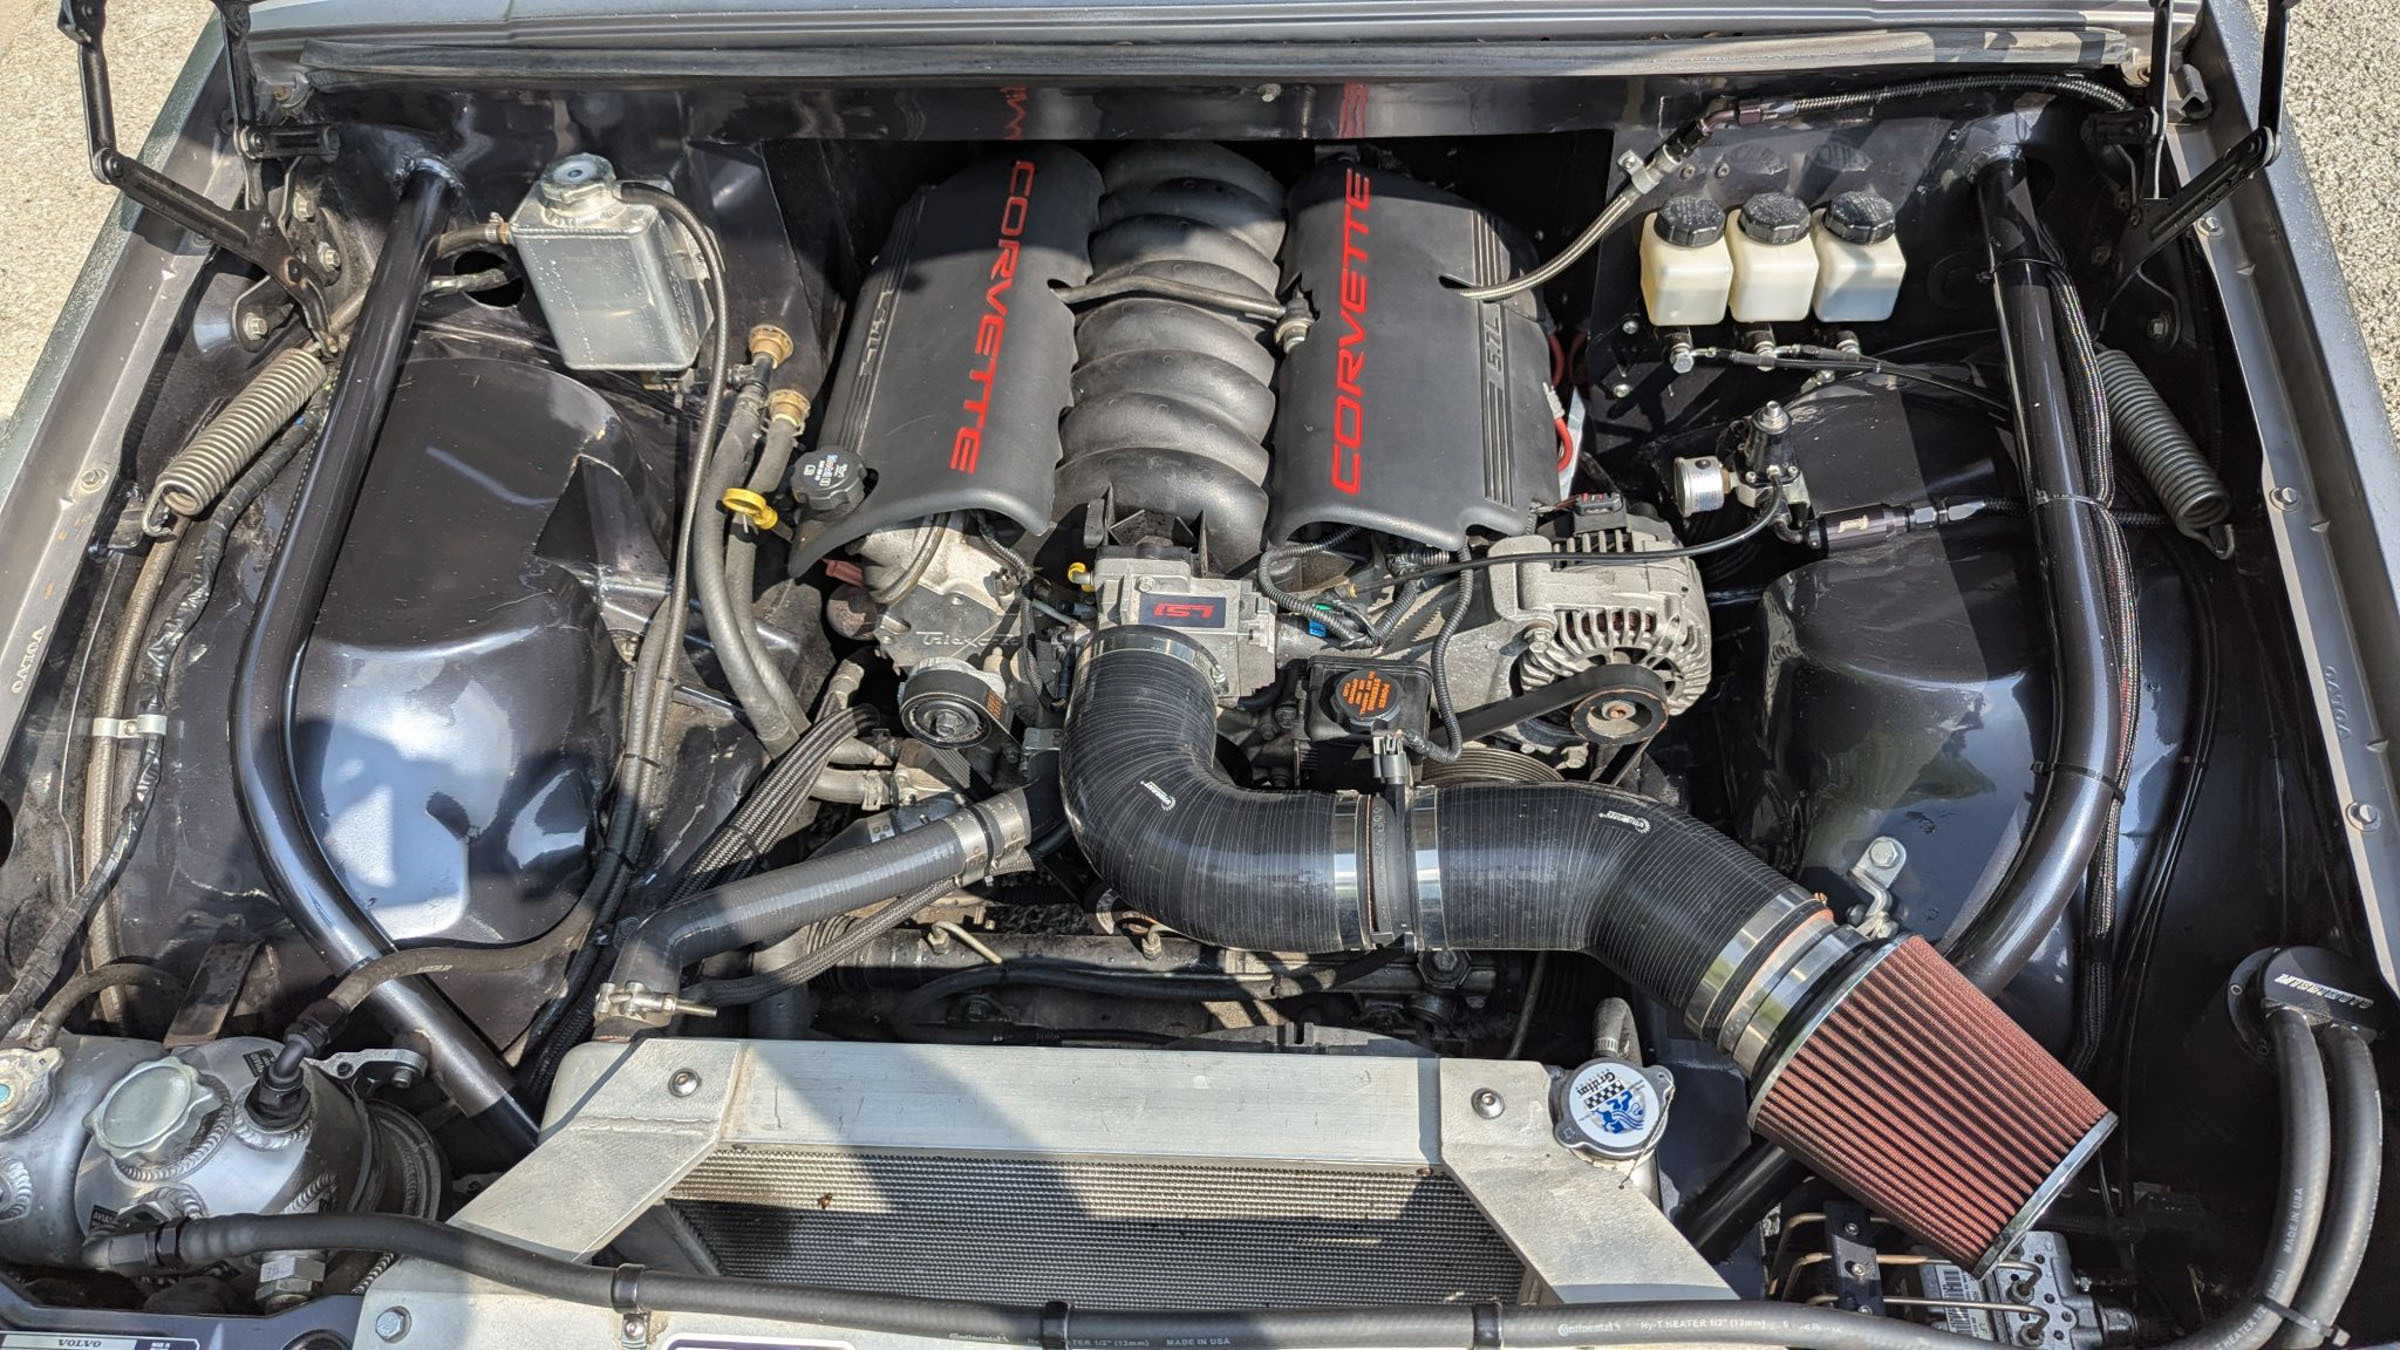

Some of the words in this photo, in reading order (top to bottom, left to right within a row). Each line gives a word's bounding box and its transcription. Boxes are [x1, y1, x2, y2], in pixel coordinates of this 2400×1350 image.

[950, 161, 1036, 475] CORVETTE
[1330, 168, 1372, 496] CORVETTE
[1484, 317, 1503, 373] 5.7L
[1154, 603, 1215, 619] LS1
[11, 625, 47, 694] VOLVO
[1367, 678, 1381, 711] STEERING
[1378, 683, 1390, 709] POWER
[2274, 973, 2374, 1009] MISHIMOTO
[1576, 1072, 1616, 1097] Griffin
[2293, 1188, 2304, 1210] USA
[2291, 1212, 2301, 1222] IN
[2284, 1224, 2298, 1253] MADE
[1557, 1321, 1613, 1336] Continental
[1664, 1319, 1706, 1329] HEATER
[2222, 1321, 2258, 1350] HEATER
[2253, 1304, 2268, 1320] 1/2
[57, 1338, 102, 1348] VOLVO
[1166, 1338, 1195, 1346] MADE
[1210, 1337, 1231, 1345] USA
